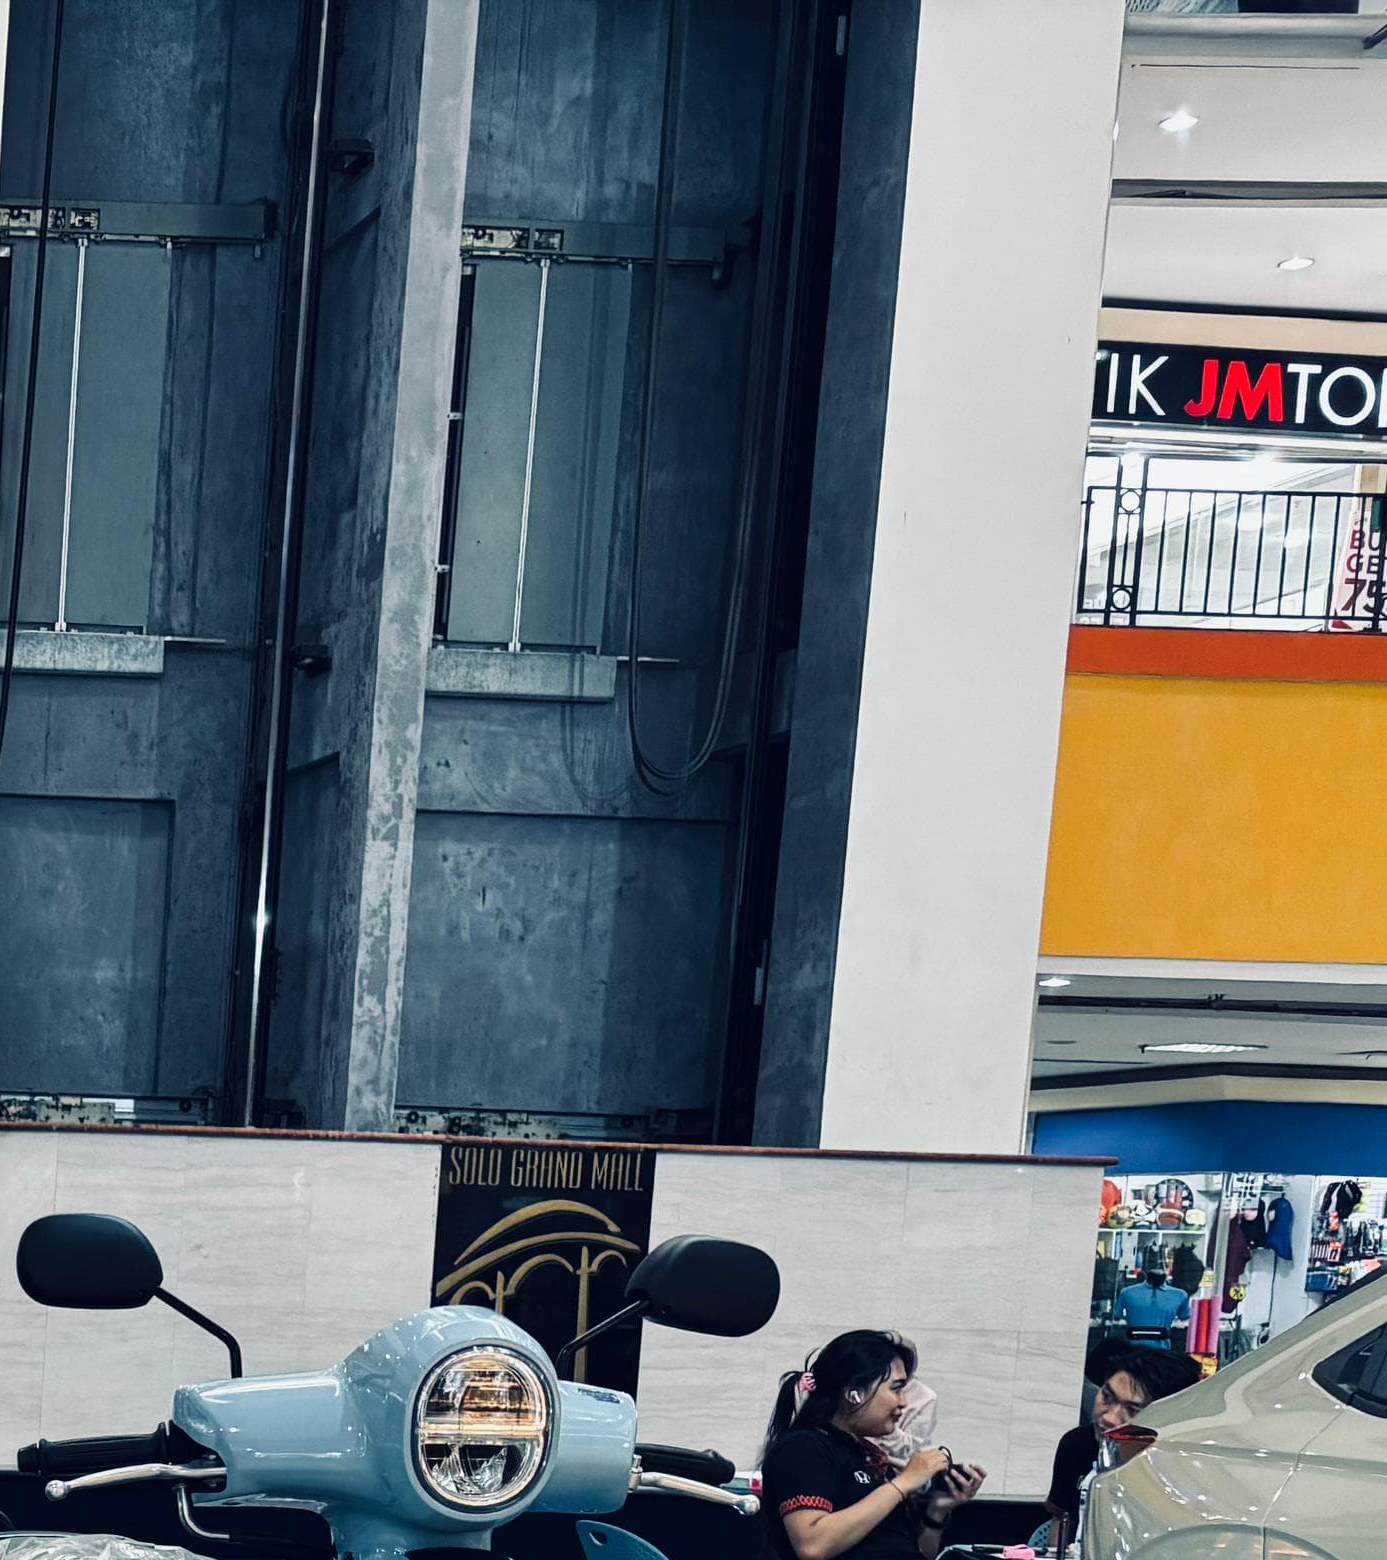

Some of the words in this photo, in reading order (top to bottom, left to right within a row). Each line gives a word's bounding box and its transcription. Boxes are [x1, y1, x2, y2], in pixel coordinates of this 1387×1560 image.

[1095, 352, 1170, 416] IK
[1184, 359, 1387, 427] JMTO
[448, 1146, 502, 1186] SOLO
[510, 1149, 584, 1189] GRAND
[591, 1152, 644, 1191] MALL
